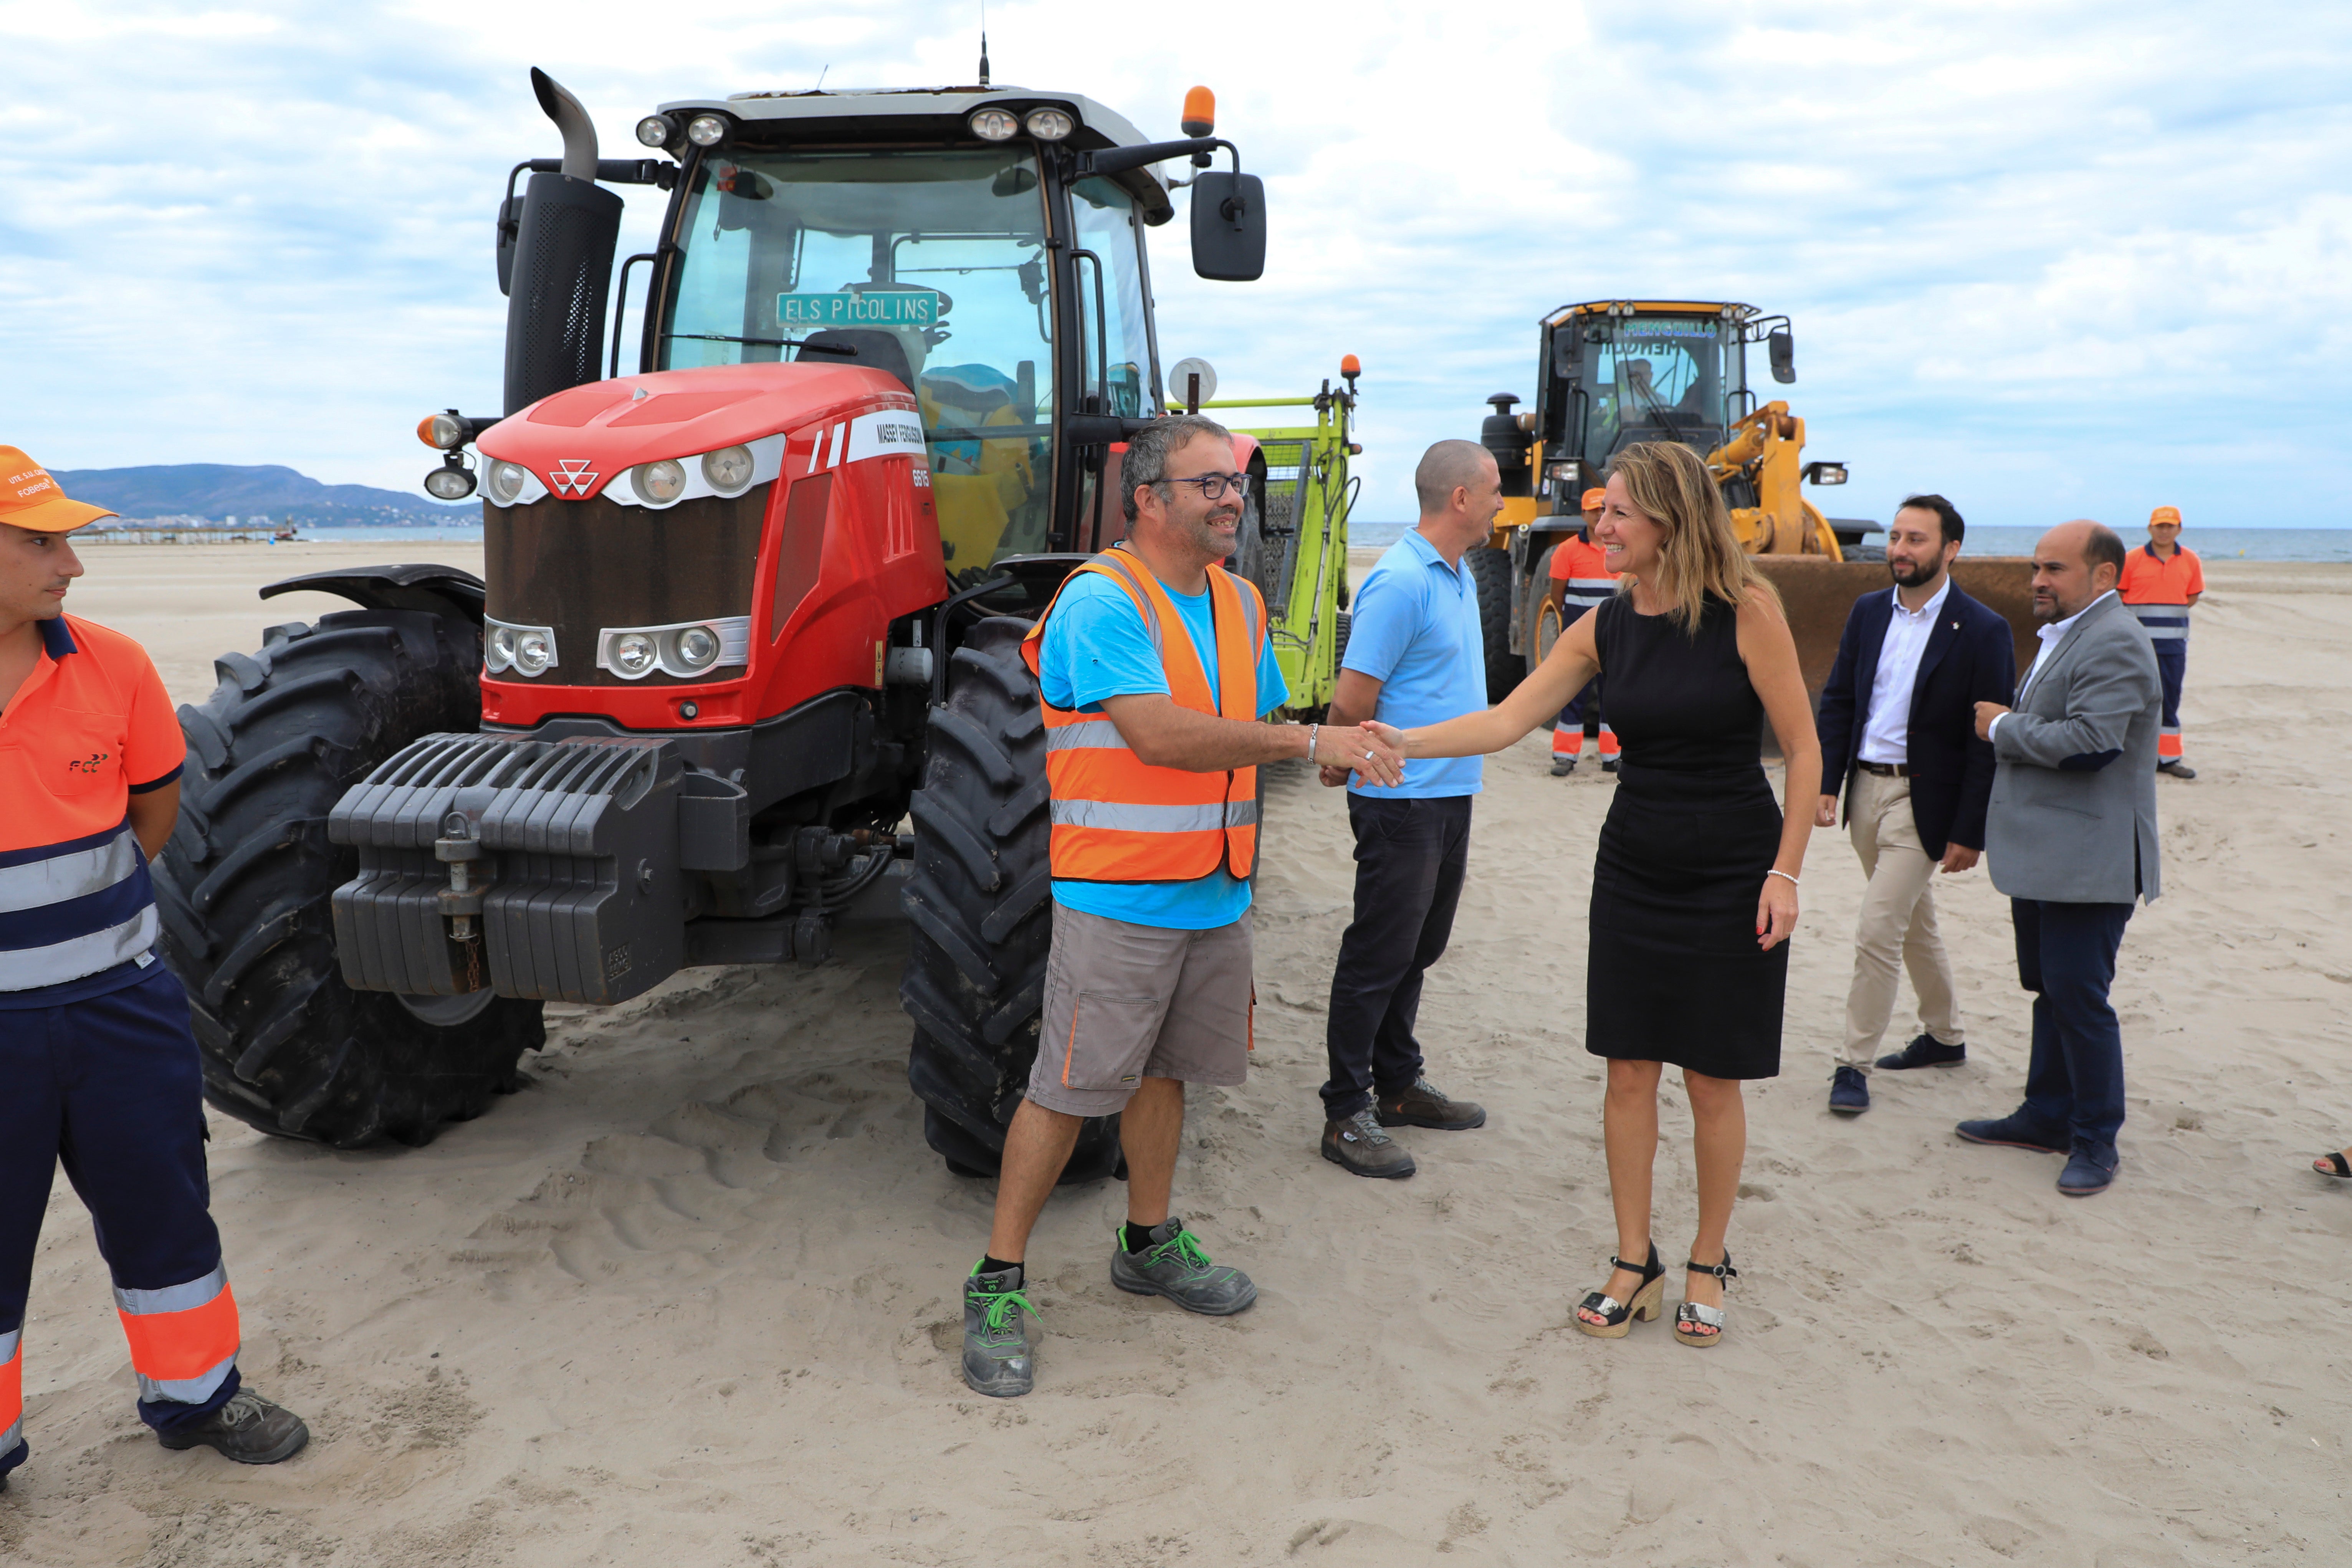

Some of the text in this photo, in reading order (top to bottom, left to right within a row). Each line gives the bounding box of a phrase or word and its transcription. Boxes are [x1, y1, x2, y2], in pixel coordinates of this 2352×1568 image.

[786, 299, 928, 320] ELS PICOLINS
[1624, 320, 1717, 339] MENGUILLÓ
[877, 423, 899, 444] MASSEY
[8, 475, 24, 484] UTE.
[22, 471, 36, 479] S.U.
[913, 469, 930, 487] 6615
[69, 761, 101, 773] FCC
